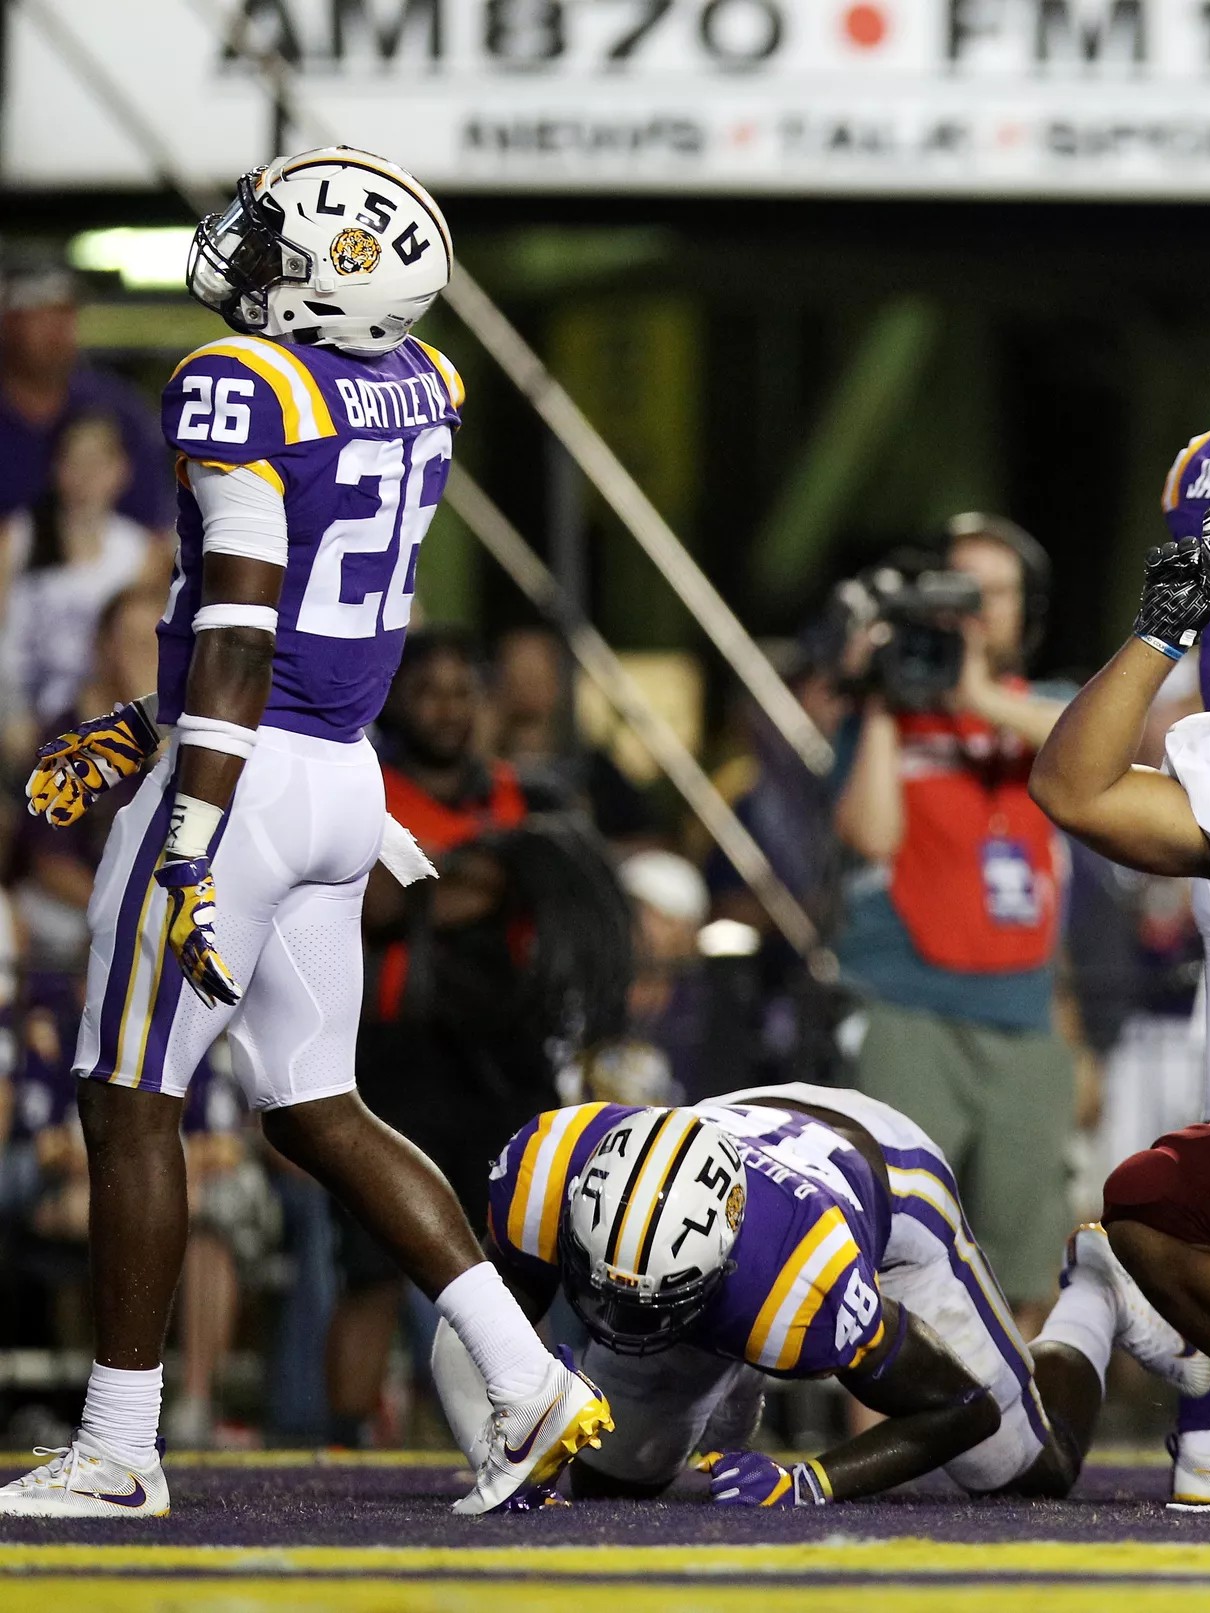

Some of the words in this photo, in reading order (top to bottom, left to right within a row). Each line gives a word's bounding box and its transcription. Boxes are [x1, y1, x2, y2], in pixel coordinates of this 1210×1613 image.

[221, 0, 442, 62] AM
[481, 0, 782, 67] 870
[946, 0, 1148, 65] FM
[176, 375, 255, 444] 26
[335, 376, 429, 428] BATTLE
[295, 425, 453, 640] 26
[834, 1267, 879, 1352] 48
